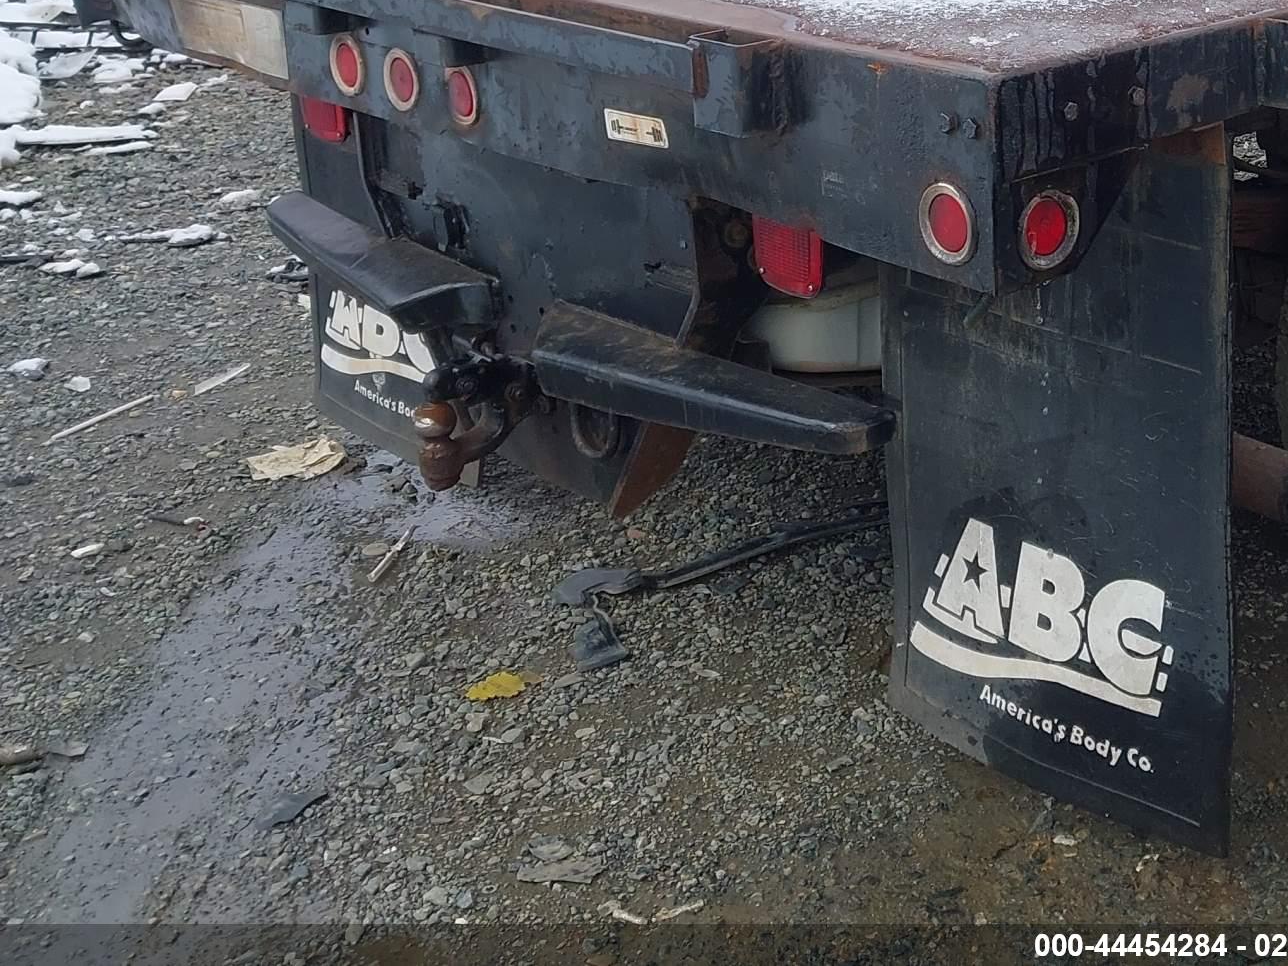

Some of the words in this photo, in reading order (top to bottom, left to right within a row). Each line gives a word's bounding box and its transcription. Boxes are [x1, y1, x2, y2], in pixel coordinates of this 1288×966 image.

[353, 378, 397, 413] America's
[934, 517, 1166, 696] ABC
[979, 684, 1067, 740] America's
[1069, 724, 1123, 767] Body
[1126, 747, 1155, 774] Co.
